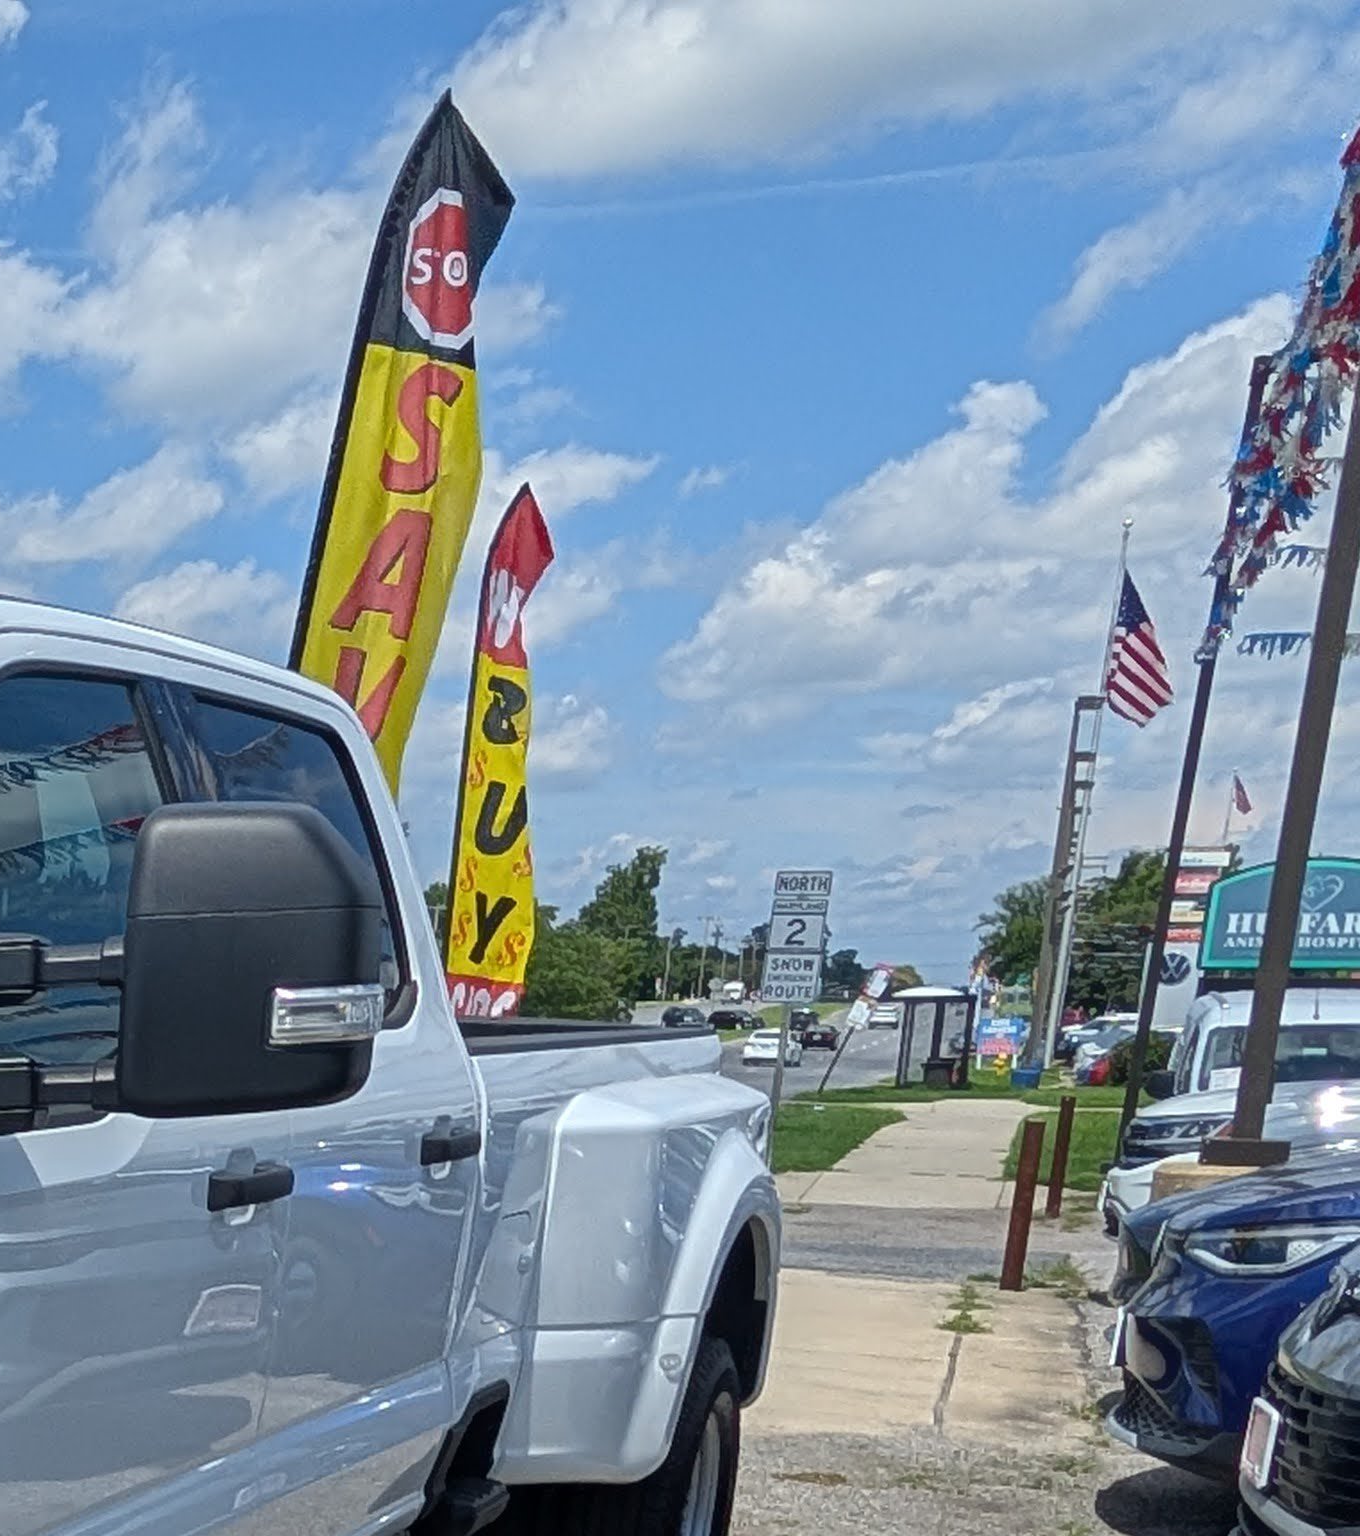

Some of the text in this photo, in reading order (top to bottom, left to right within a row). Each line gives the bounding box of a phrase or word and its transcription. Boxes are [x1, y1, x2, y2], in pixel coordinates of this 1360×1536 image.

[468, 675, 528, 964] BUY
[777, 876, 829, 891] NORTH
[784, 918, 807, 946] 2
[770, 957, 815, 971] SNOW
[763, 986, 812, 999] ROUTE
